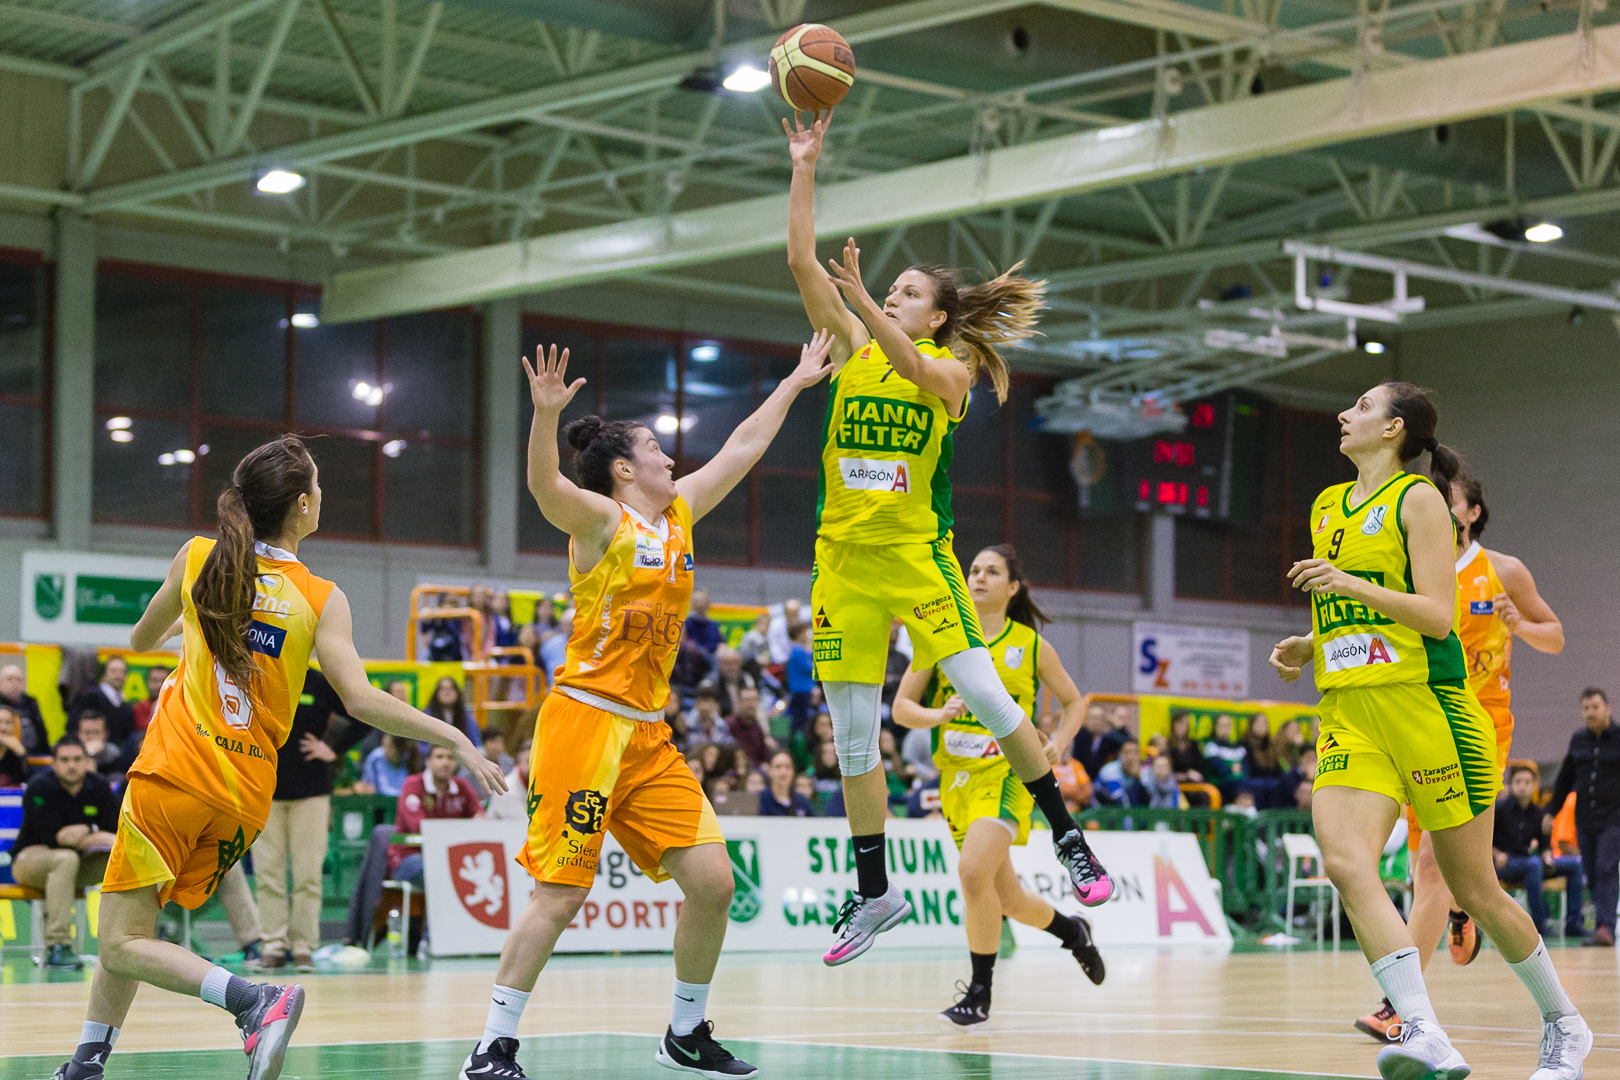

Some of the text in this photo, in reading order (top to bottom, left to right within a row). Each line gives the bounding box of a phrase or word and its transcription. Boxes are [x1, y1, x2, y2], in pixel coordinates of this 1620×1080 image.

[846, 400, 929, 431] MANN
[839, 423, 923, 450] FILTER
[848, 468, 895, 481] ARAGÓN
[1327, 528, 1345, 561] 9
[251, 591, 291, 619] EOS
[922, 602, 954, 618] DEPORTE
[592, 594, 614, 659] VALCARCE
[248, 628, 276, 649] ONA
[214, 735, 245, 754] CAJA
[1320, 754, 1346, 768] ANN
[1422, 762, 1459, 777] Zaragoza
[1425, 770, 1460, 785] DEPORTE
[1435, 790, 1465, 803] MERCURY
[567, 839, 598, 858] Sfera
[807, 836, 948, 875] STAIUM
